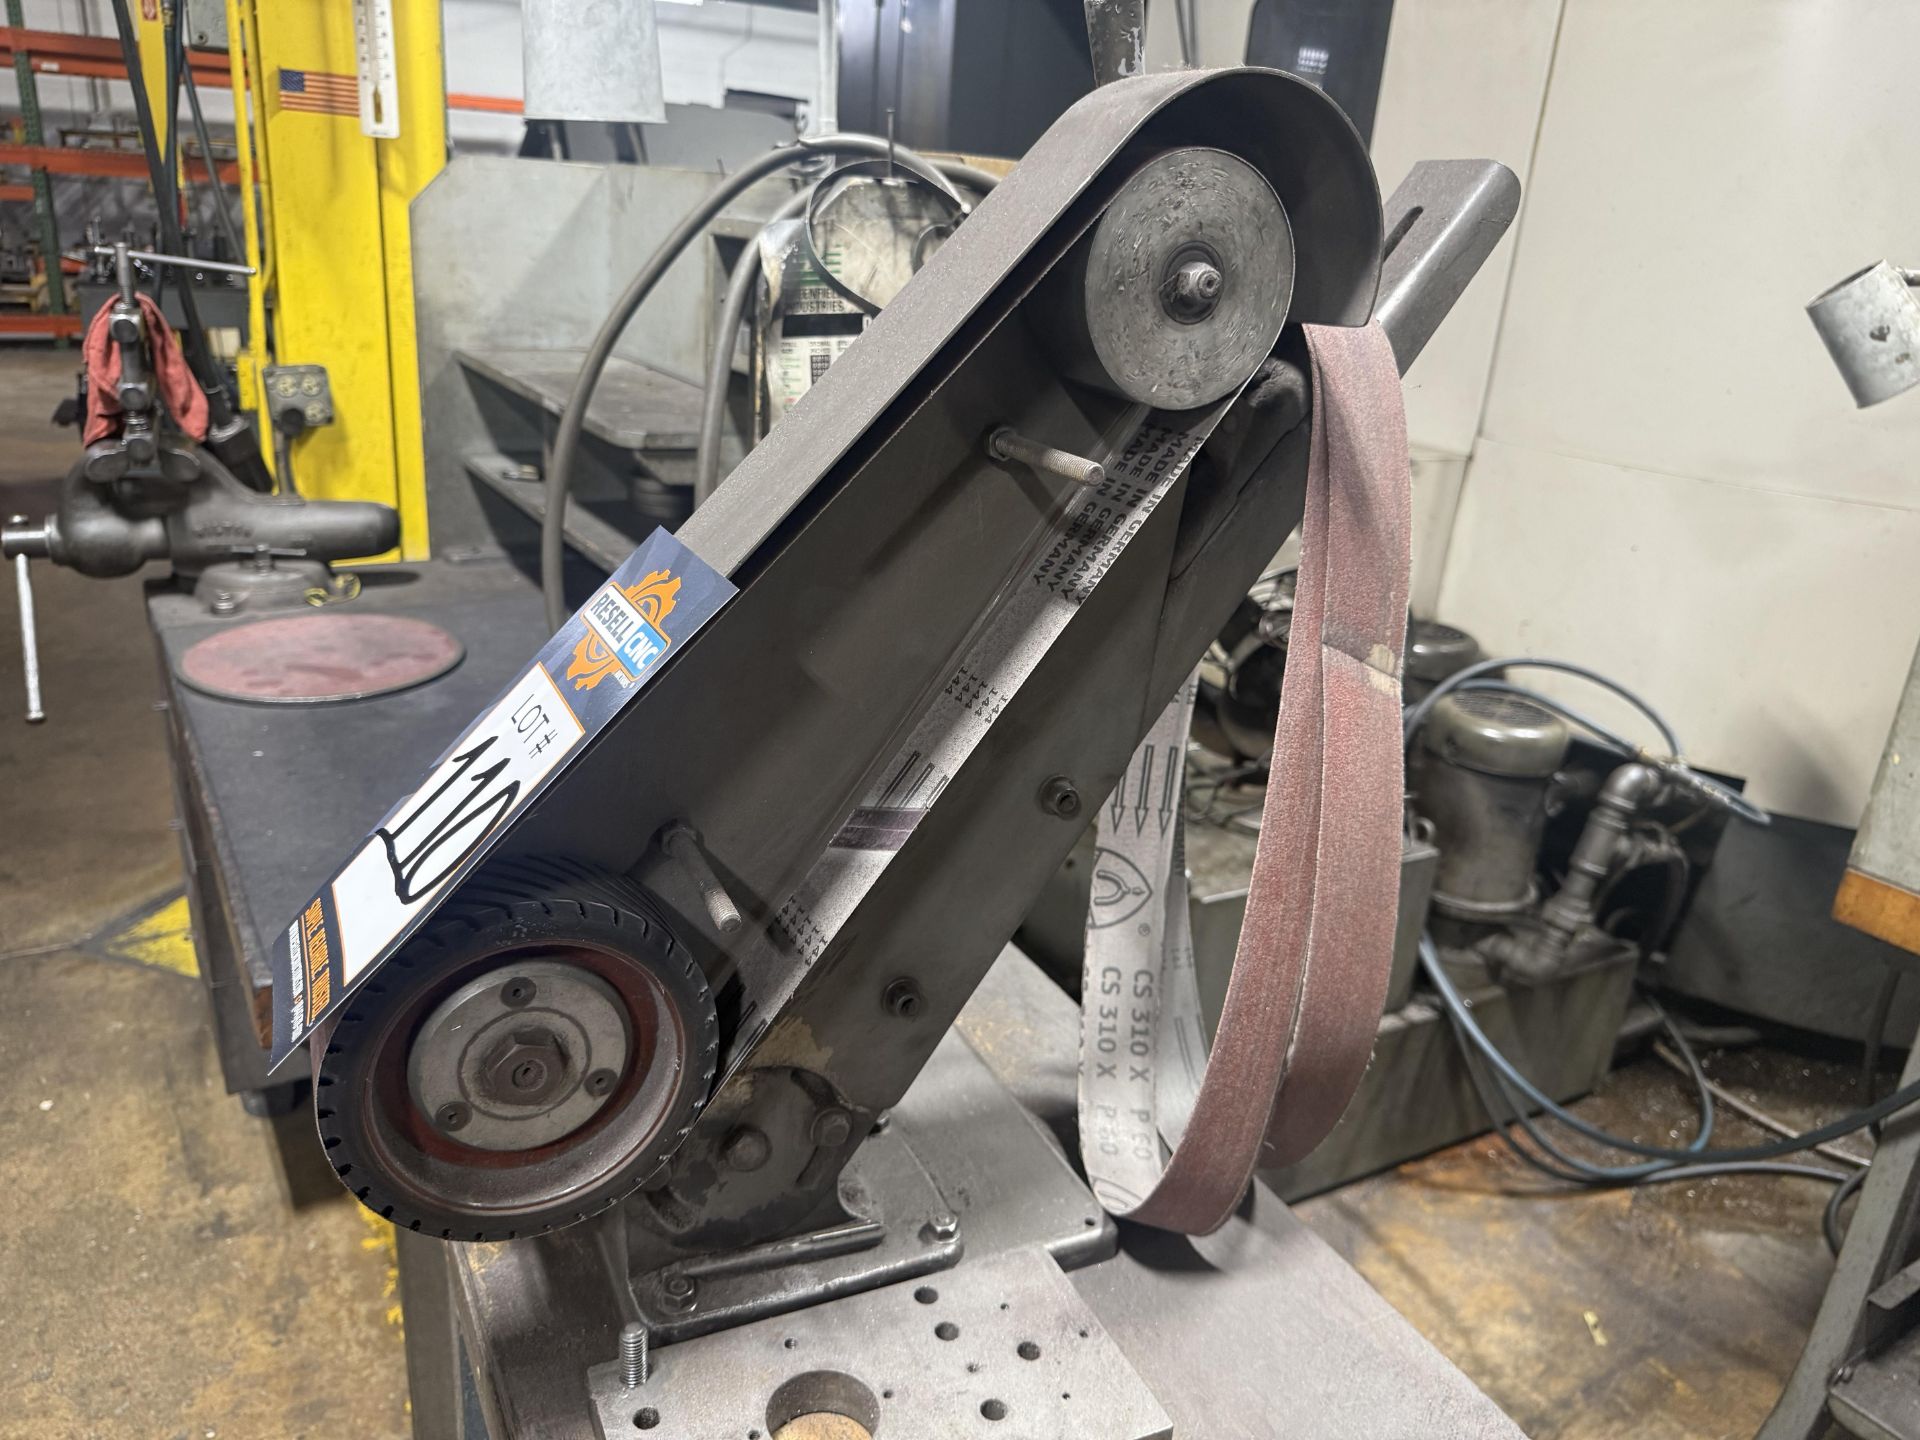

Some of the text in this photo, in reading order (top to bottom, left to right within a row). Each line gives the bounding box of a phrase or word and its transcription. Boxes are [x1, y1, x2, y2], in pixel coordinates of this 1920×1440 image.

[1033, 422, 1156, 585] MADE IN GERMANY
[1047, 426, 1173, 592] MADE IN GERMANY
[1060, 431, 1189, 600] MADE IN GERMANY
[1074, 436, 1205, 606] MADE IN GERMANY
[590, 592, 634, 644] RESELL
[624, 631, 660, 670] CNC
[945, 666, 968, 694] 144
[955, 674, 978, 702] 144
[965, 681, 988, 709] 144
[975, 688, 998, 717] 144
[985, 695, 1008, 723] 144
[511, 693, 558, 759] LOT #
[375, 735, 521, 905] 110
[797, 925, 820, 956] 144
[805, 936, 828, 967] 144
[1101, 966, 1121, 995] CS
[1133, 969, 1154, 998] CS
[1097, 1005, 1117, 1053] 310
[1130, 1007, 1150, 1056] 310
[1096, 1063, 1117, 1079] X
[1129, 1065, 1150, 1082] X
[1130, 1109, 1150, 1122] P
